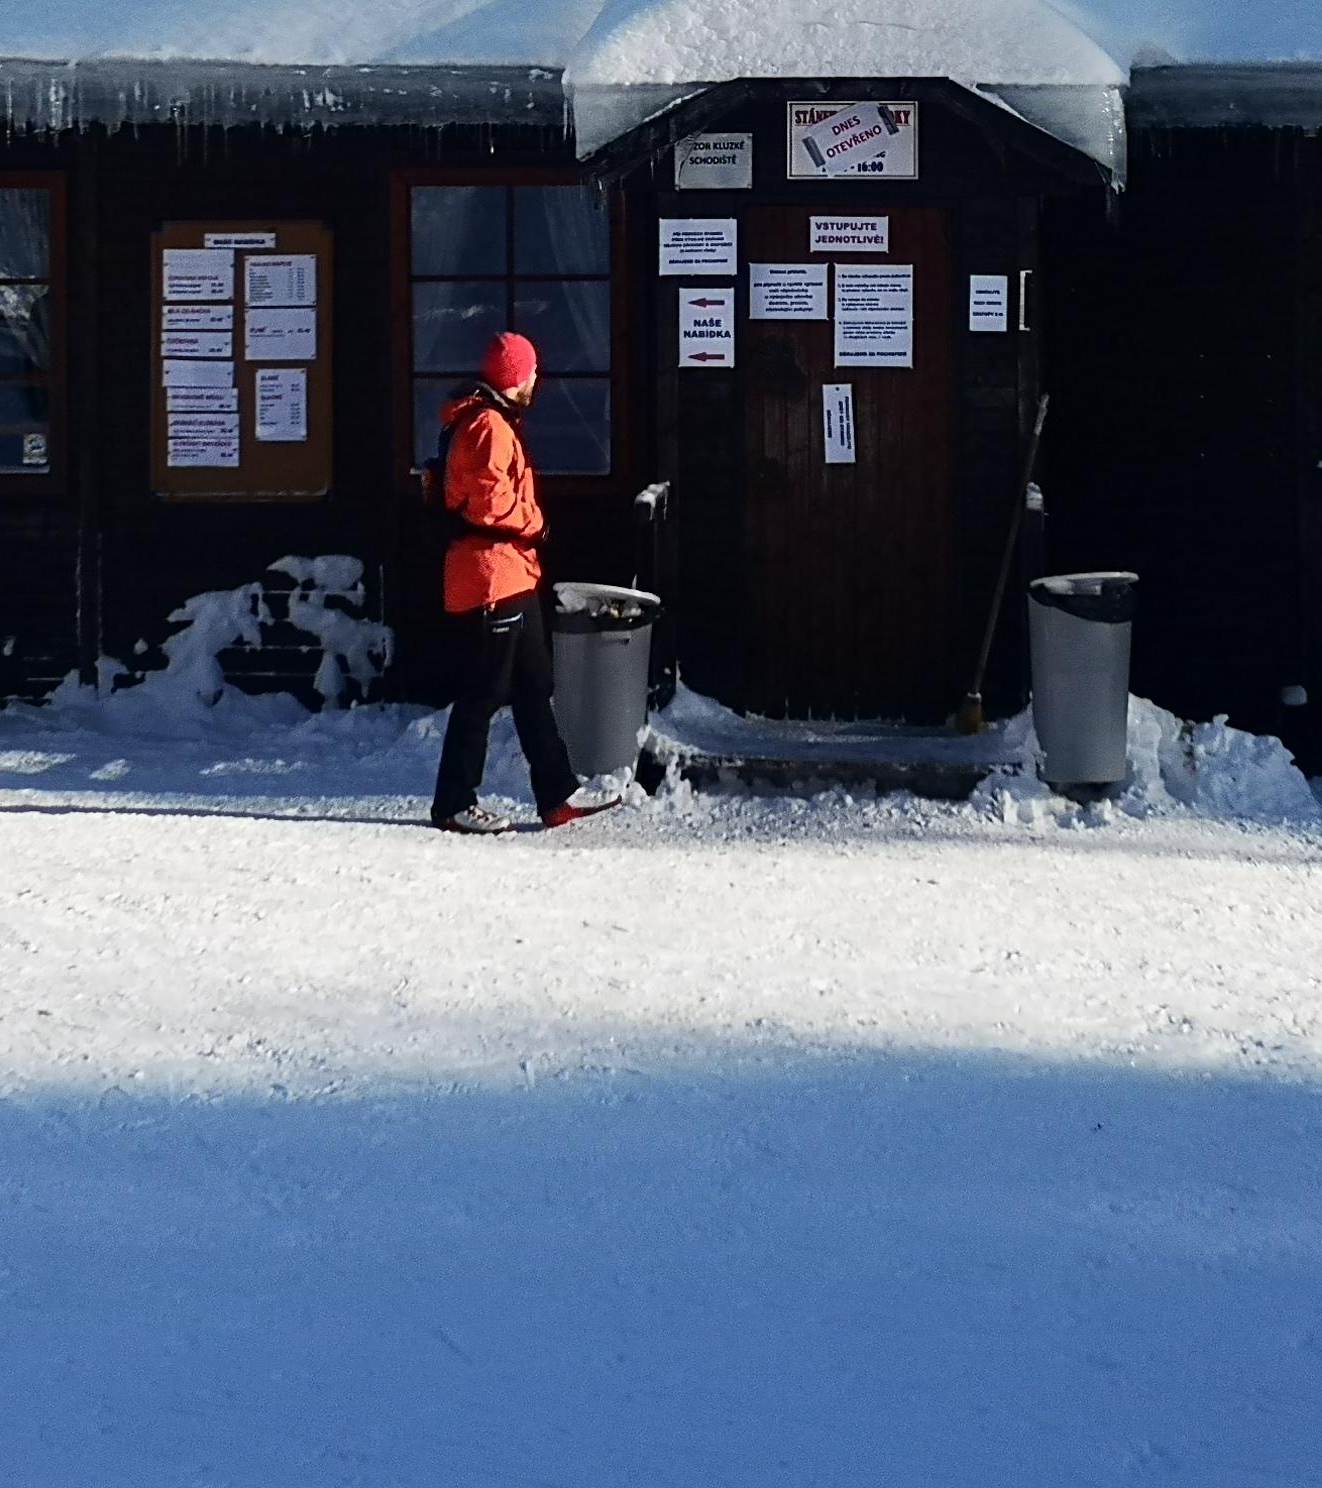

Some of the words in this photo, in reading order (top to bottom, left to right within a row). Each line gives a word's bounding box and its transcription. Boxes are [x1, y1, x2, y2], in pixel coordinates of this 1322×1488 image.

[832, 115, 861, 136] DNES
[693, 142, 711, 151] ZOR
[713, 140, 745, 151] KLUZKÉ
[826, 124, 882, 158] OTEVŘENO
[689, 154, 737, 165] SCHODIŠTĚ
[857, 161, 884, 172] 16:00
[815, 222, 877, 231] VSTUPUJTE
[815, 234, 884, 244] JEDNOTLIVĚ!
[693, 317, 722, 327] NAŠE
[683, 329, 731, 339] NABÍDKA
